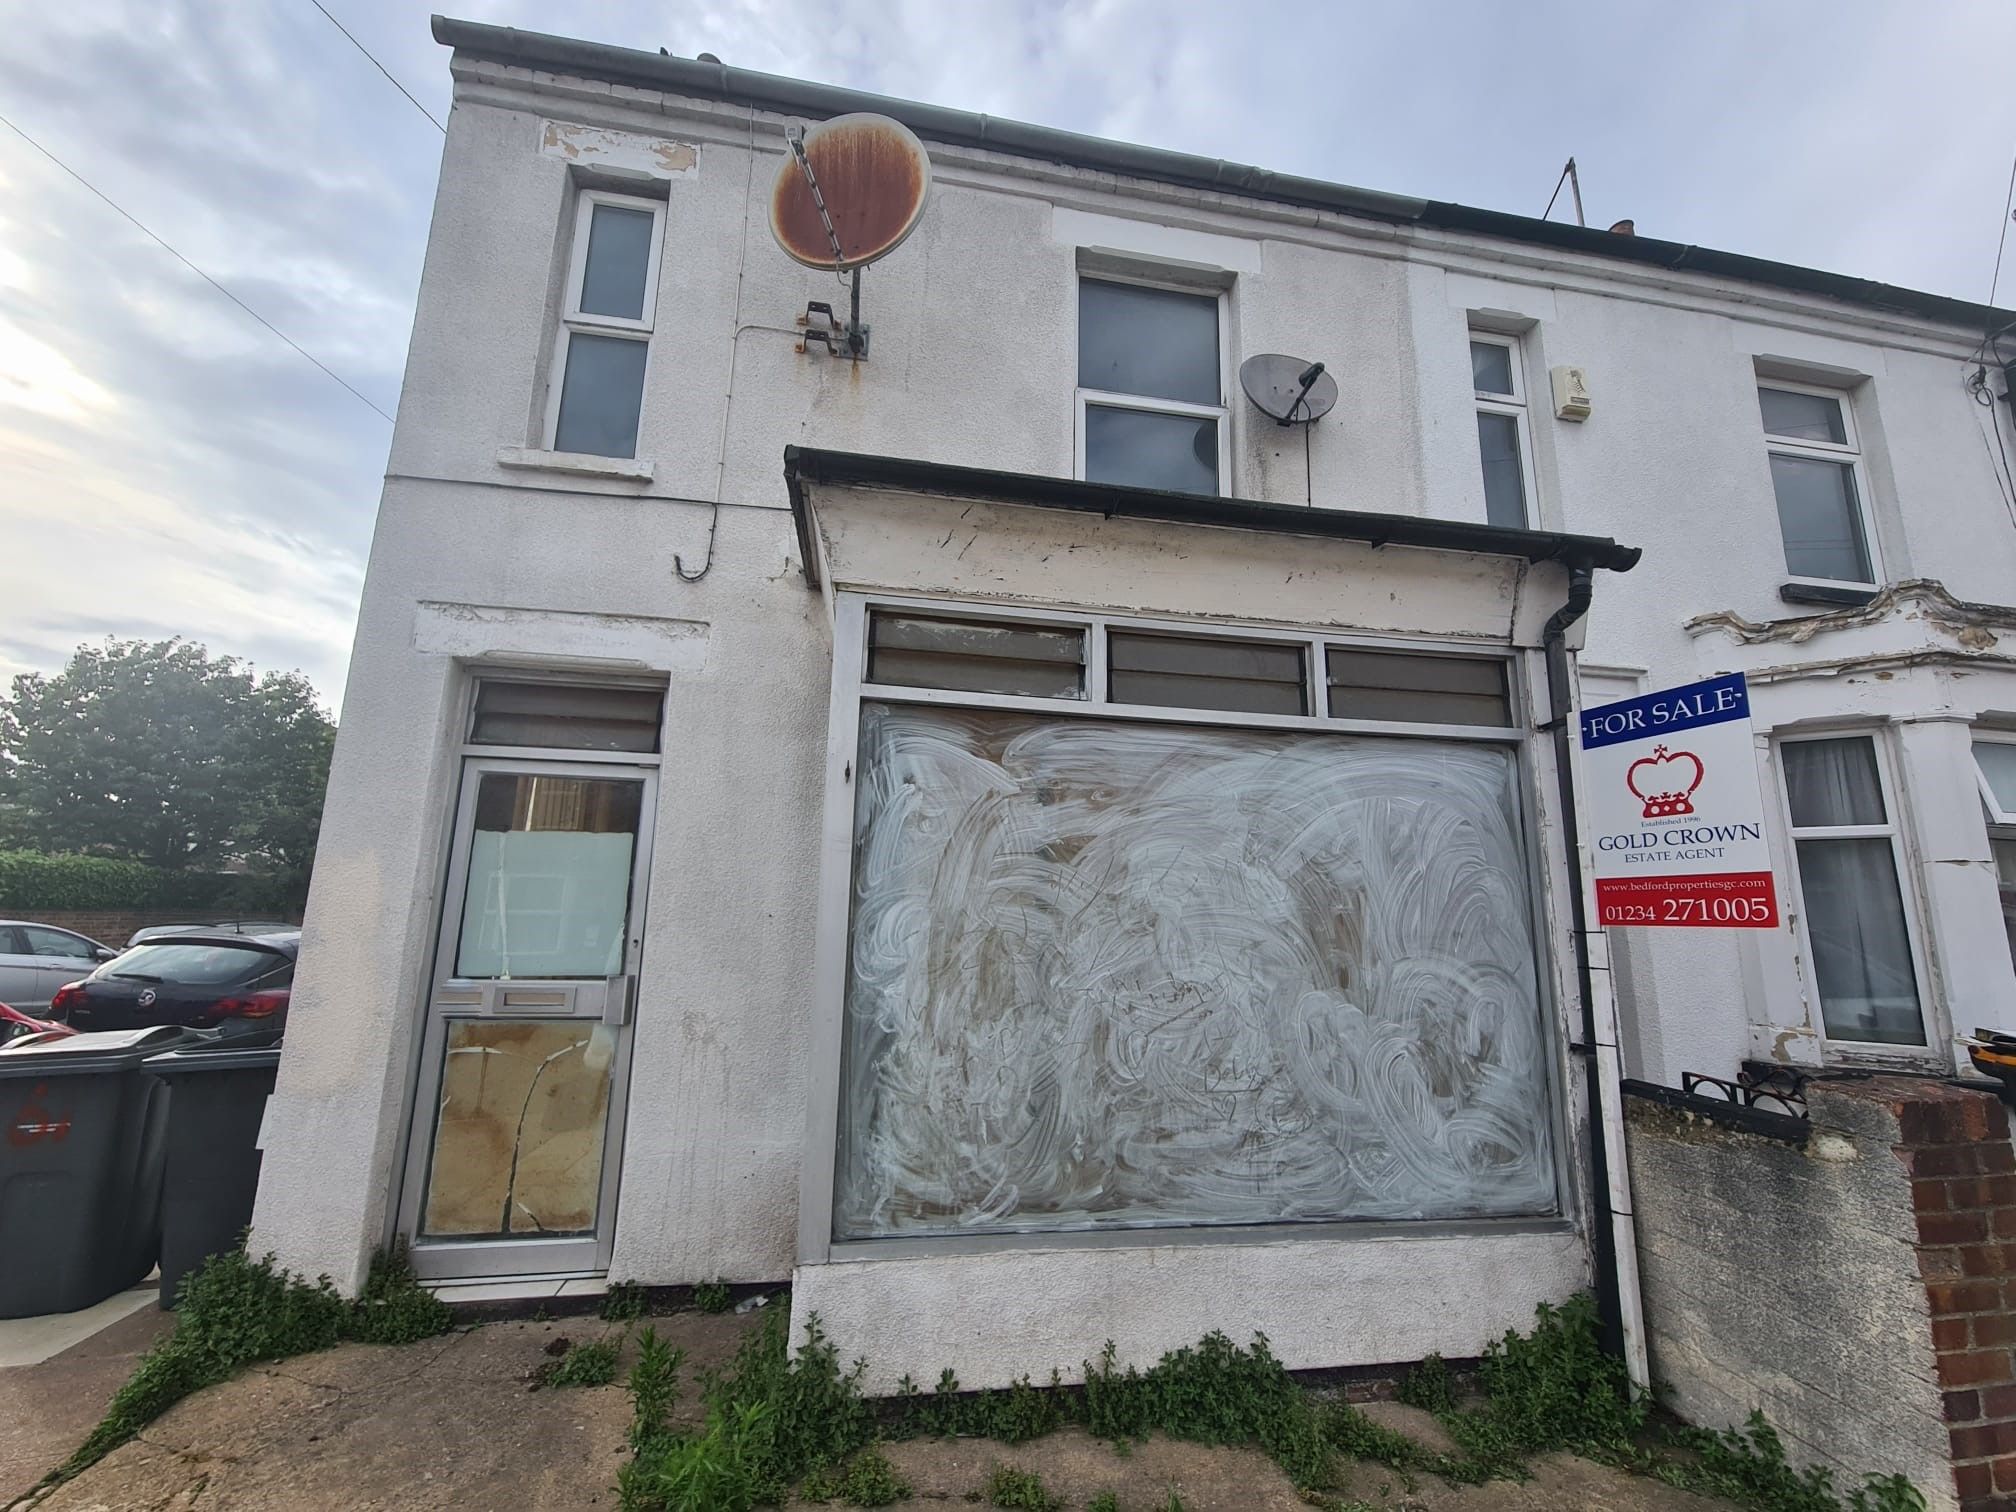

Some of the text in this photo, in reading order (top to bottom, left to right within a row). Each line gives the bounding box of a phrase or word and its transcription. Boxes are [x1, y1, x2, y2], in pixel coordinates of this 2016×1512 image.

[1589, 686, 1737, 739] FOR SALE
[1641, 817, 1682, 828] Established
[1599, 822, 1761, 851] GOLD CROWN
[1625, 847, 1725, 863] ESTATE AGENT
[1603, 879, 1766, 892] www.bedfordpropertiesgc.com
[1605, 897, 1770, 922] 01234 271005
